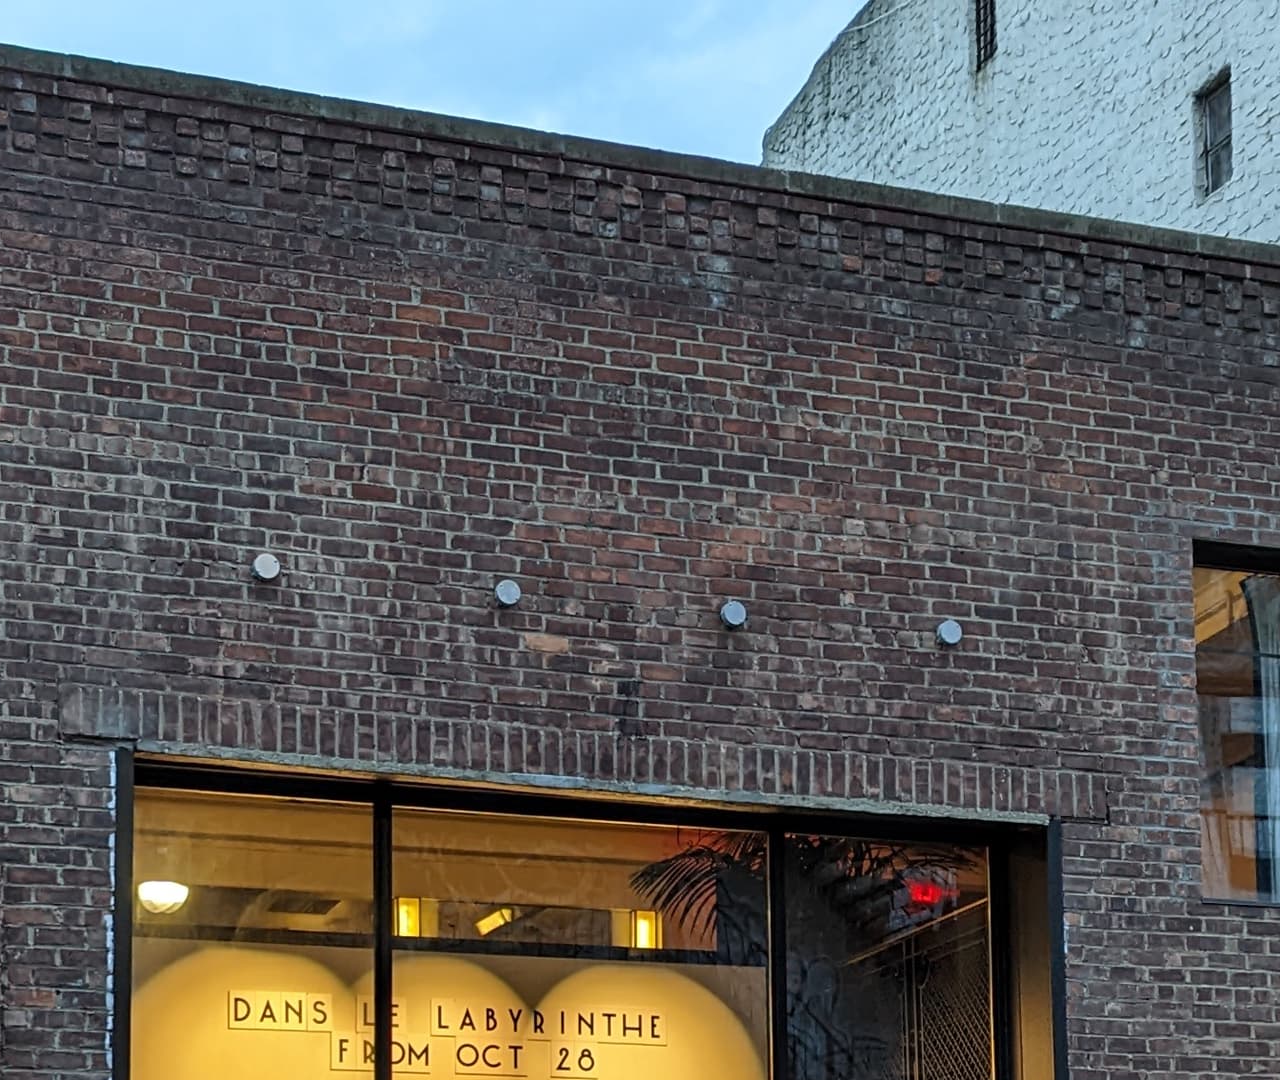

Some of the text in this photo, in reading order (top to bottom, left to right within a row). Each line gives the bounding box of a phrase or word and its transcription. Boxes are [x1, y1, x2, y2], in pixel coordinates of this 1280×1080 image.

[233, 997, 662, 1040] DANS LE LABYRINTHE
[339, 1038, 595, 1071] FROM OCT 28
